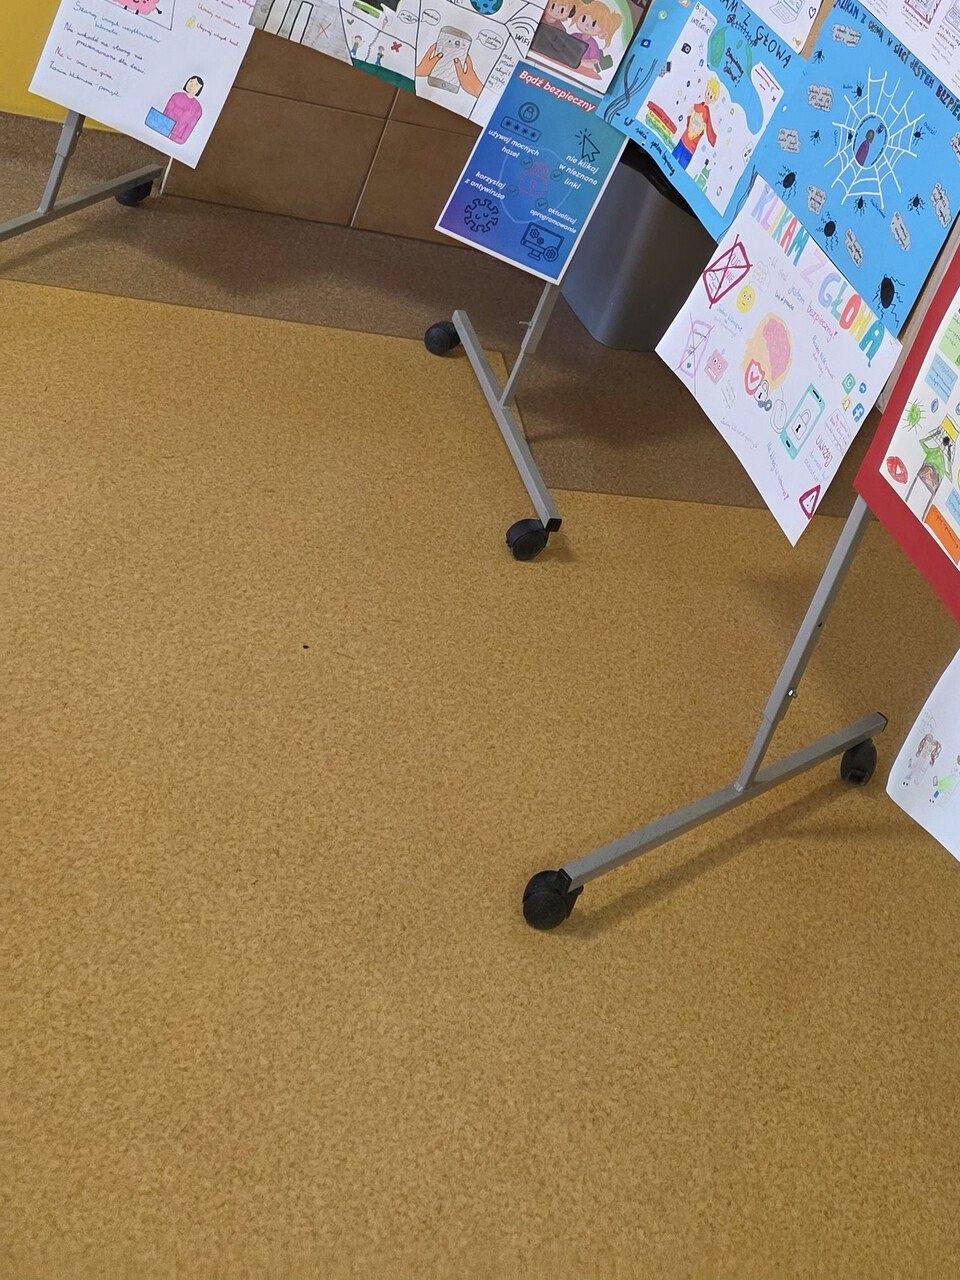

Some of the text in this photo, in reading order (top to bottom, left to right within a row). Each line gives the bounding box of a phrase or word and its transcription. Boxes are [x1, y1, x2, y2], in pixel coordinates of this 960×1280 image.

[755, 24, 793, 70] GŁOWĄ
[519, 70, 596, 112] Bądź bezpieczny
[488, 129, 540, 156] używaj mocnych
[501, 146, 520, 159] haseł
[566, 154, 600, 174] nie klikaj
[475, 171, 507, 190] korzystaj
[564, 178, 582, 190] linki
[565, 166, 598, 186] nieznane
[470, 179, 506, 201] antywirusa
[529, 208, 577, 234] oprogramowanie
[547, 207, 578, 225] aktualizuj
[750, 184, 811, 269] KLIKAM
